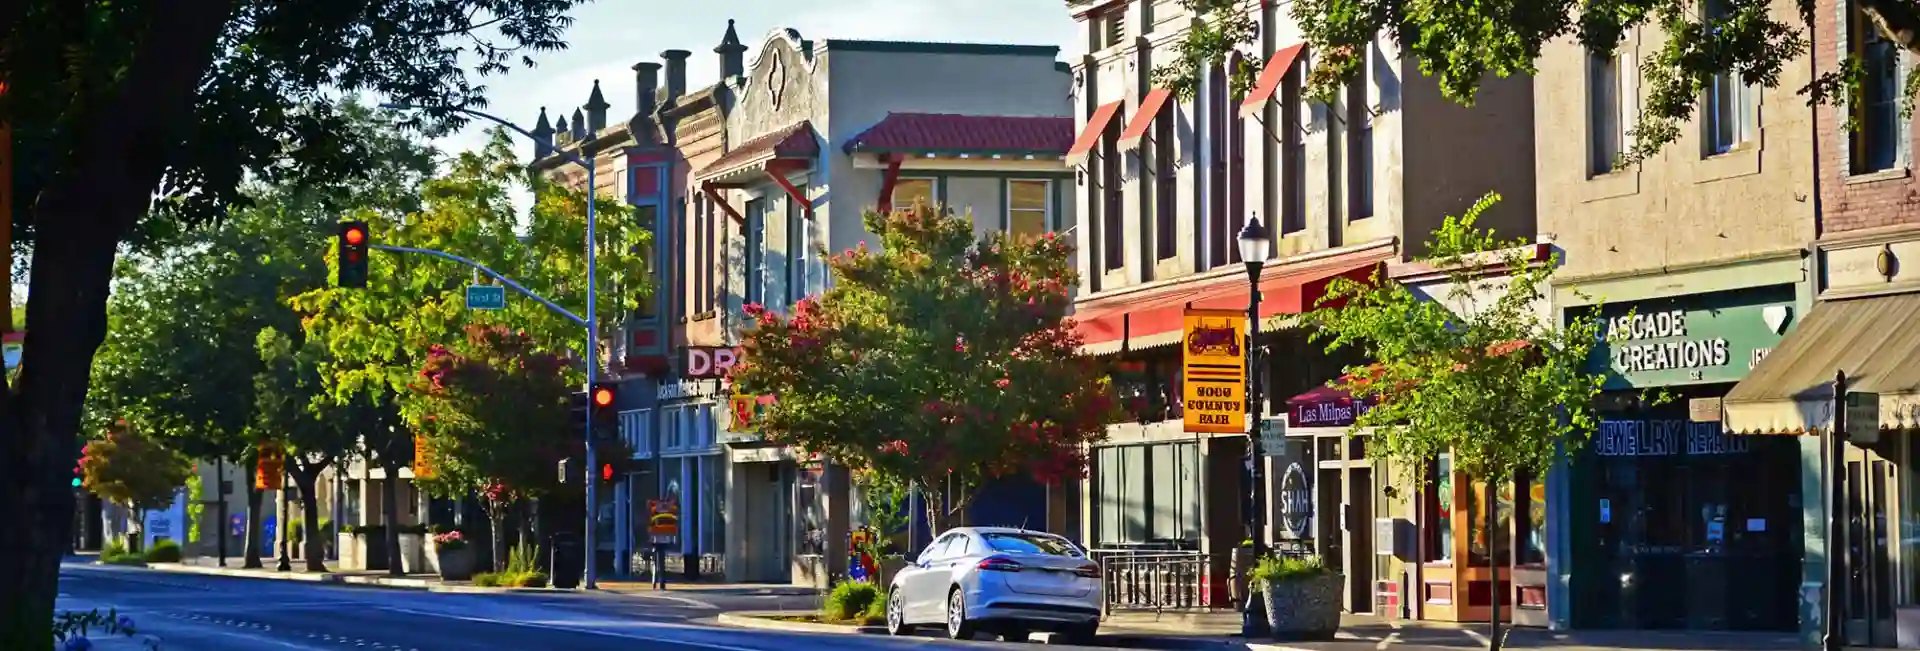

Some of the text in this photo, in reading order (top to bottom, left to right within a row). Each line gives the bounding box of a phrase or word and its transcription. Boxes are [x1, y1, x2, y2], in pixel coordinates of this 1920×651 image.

[1594, 310, 1684, 342] CASCADE
[688, 349, 736, 375] DR
[1619, 338, 1727, 371] CREATIONS
[1298, 400, 1372, 425] Las Milpas Ta
[1596, 420, 1681, 455] JEWELRY
[1281, 490, 1308, 514] SHAH
